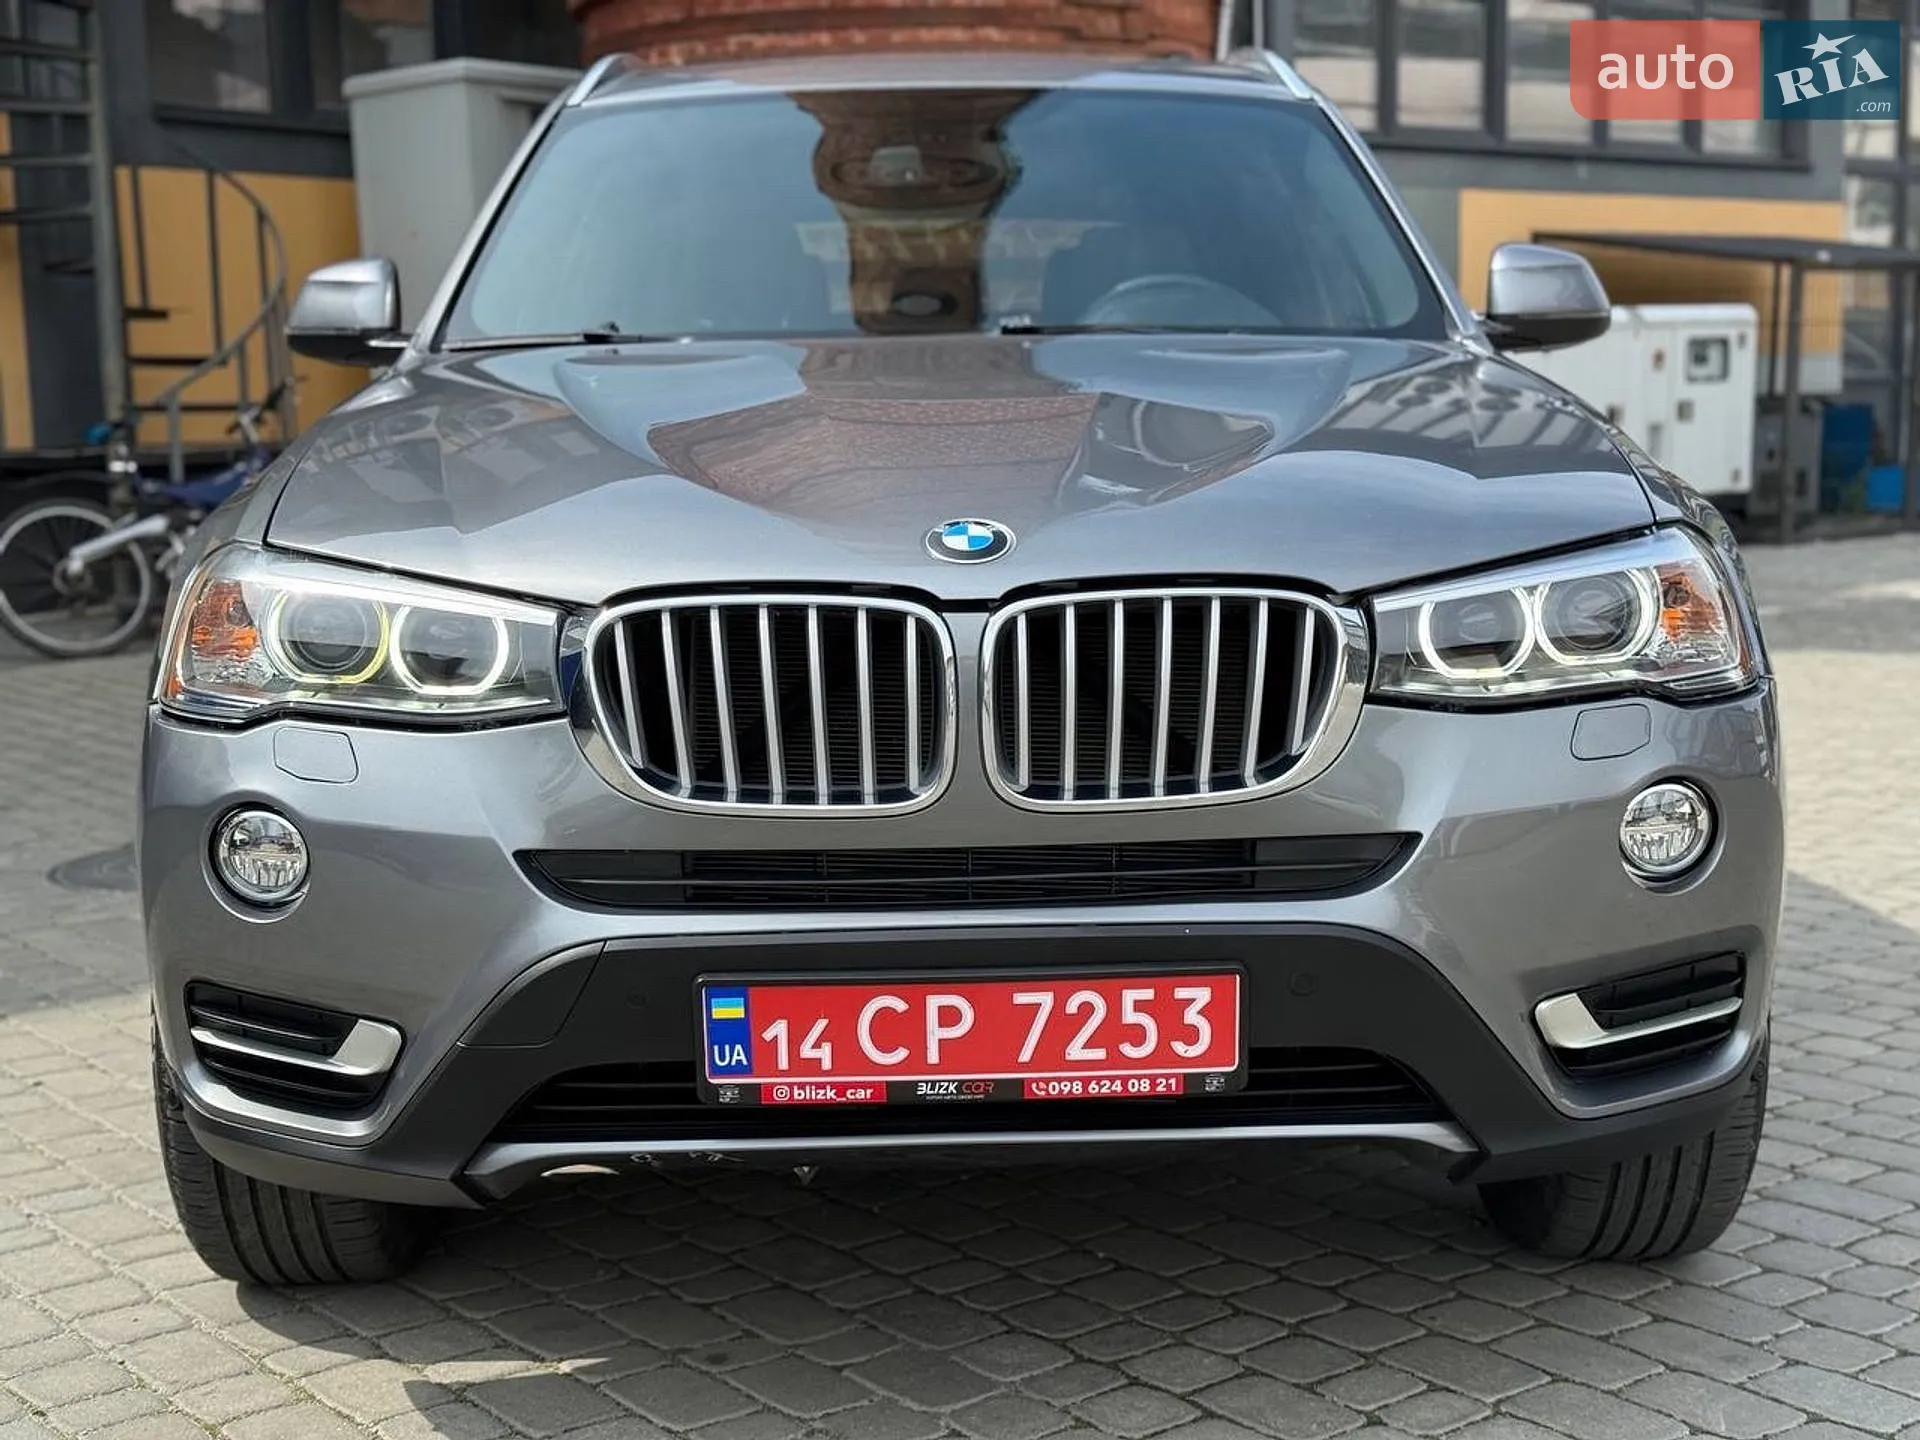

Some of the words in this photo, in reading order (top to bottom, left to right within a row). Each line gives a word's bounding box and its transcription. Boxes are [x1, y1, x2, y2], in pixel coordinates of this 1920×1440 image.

[761, 1018, 832, 1071] 14
[857, 994, 975, 1066] CP
[1013, 987, 1212, 1064] 7253
[713, 1044, 748, 1067] UA
[793, 1085, 874, 1102] blizk_car
[1048, 1081, 1083, 1095] 098
[1087, 1079, 1123, 1093] 624
[1128, 1078, 1151, 1092] 08
[1156, 1077, 1177, 1092] 21
